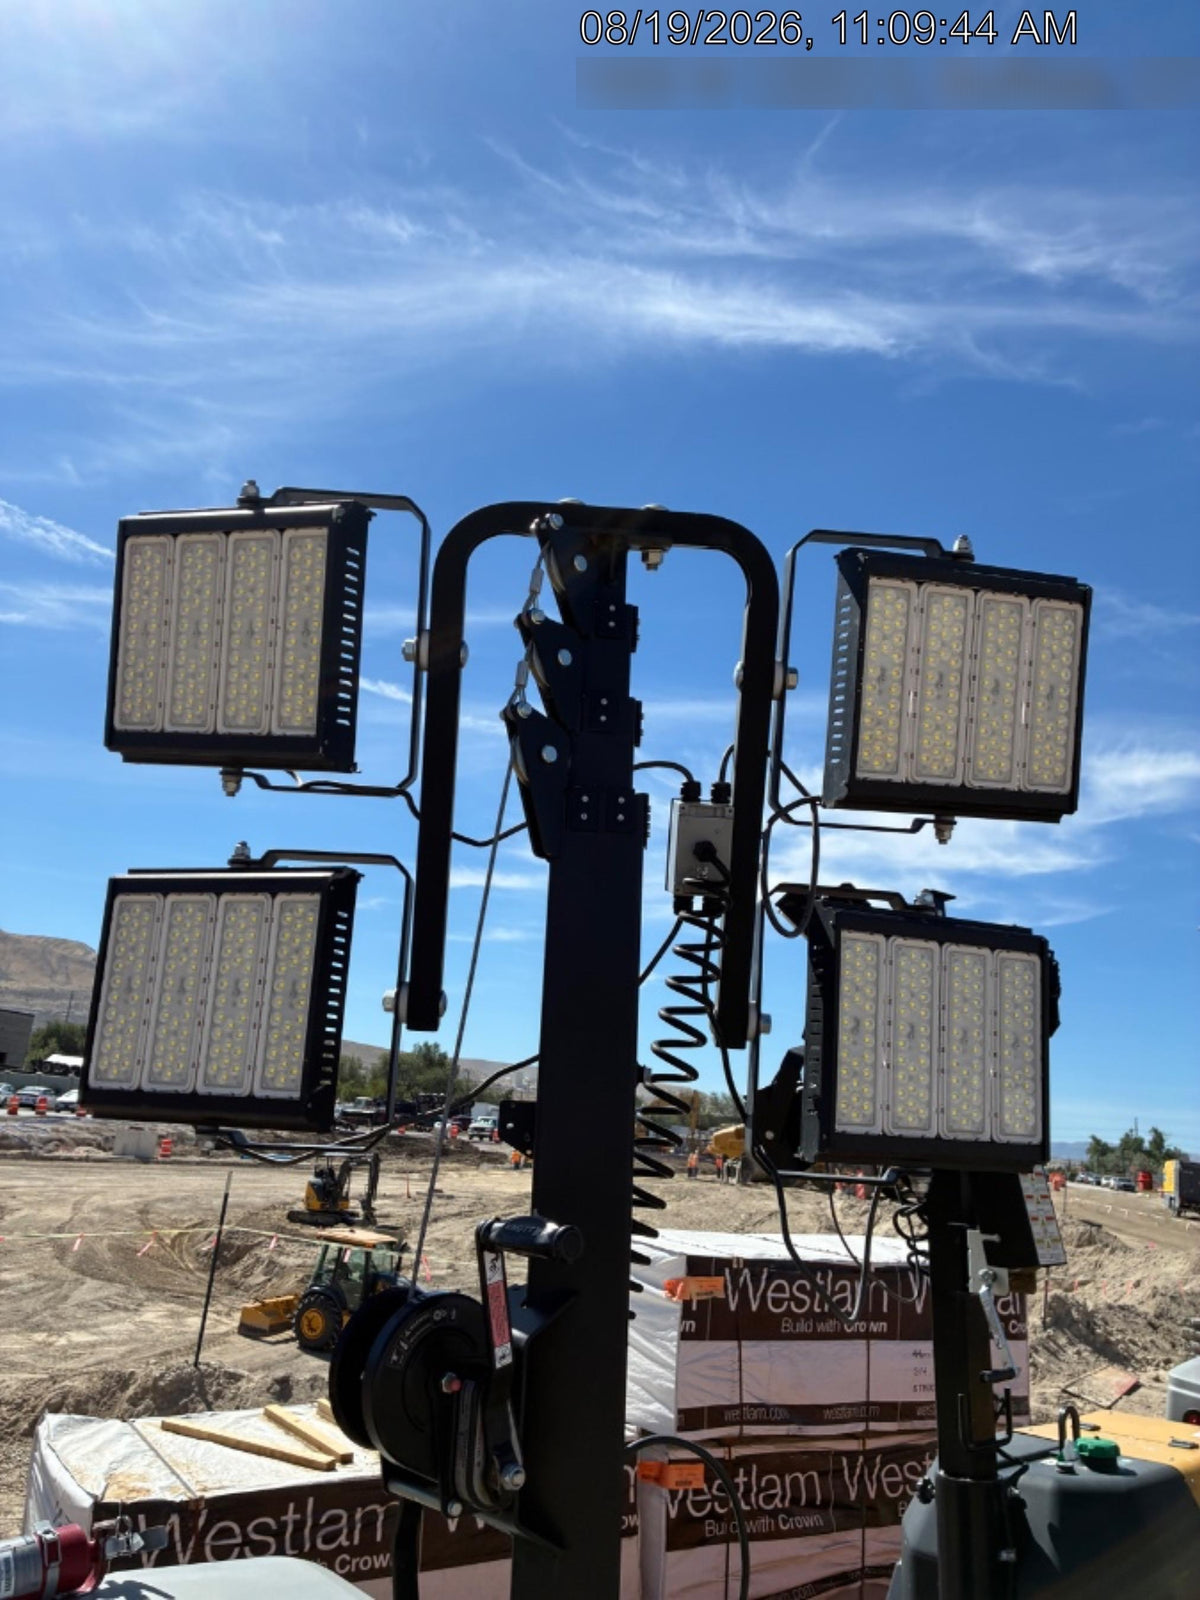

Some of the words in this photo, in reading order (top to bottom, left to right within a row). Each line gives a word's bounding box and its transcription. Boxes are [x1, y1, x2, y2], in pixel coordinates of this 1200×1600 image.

[724, 1266, 889, 1314] Westlam
[780, 1317, 814, 1334] Build
[815, 1318, 841, 1333] with
[744, 1514, 776, 1534] with
[777, 1513, 825, 1531] Crown
[334, 1553, 392, 1574] Crow
